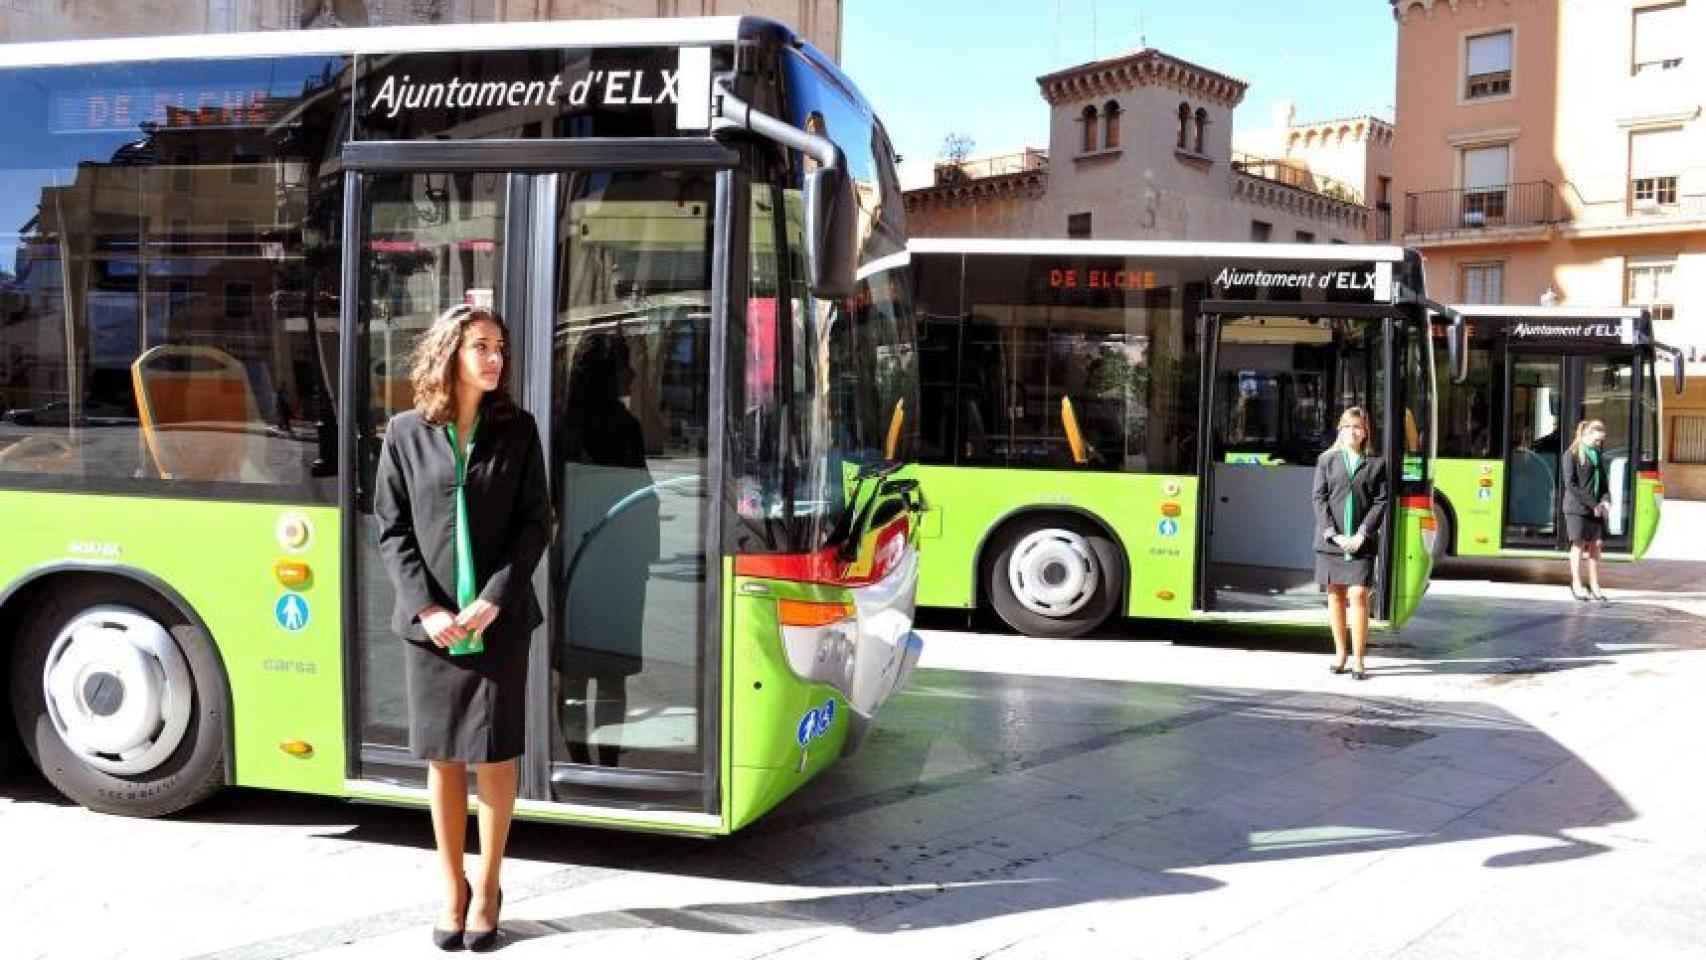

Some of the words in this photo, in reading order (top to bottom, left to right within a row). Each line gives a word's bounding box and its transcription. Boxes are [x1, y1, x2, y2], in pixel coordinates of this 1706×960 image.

[370, 74, 563, 118] Ajuntament
[568, 69, 681, 106] d'ELX
[87, 93, 130, 127] DE
[1050, 269, 1077, 287] DE
[1214, 267, 1316, 290] Ajuntament
[1319, 271, 1377, 290] d'ELX
[1513, 322, 1582, 338] Ajuntament
